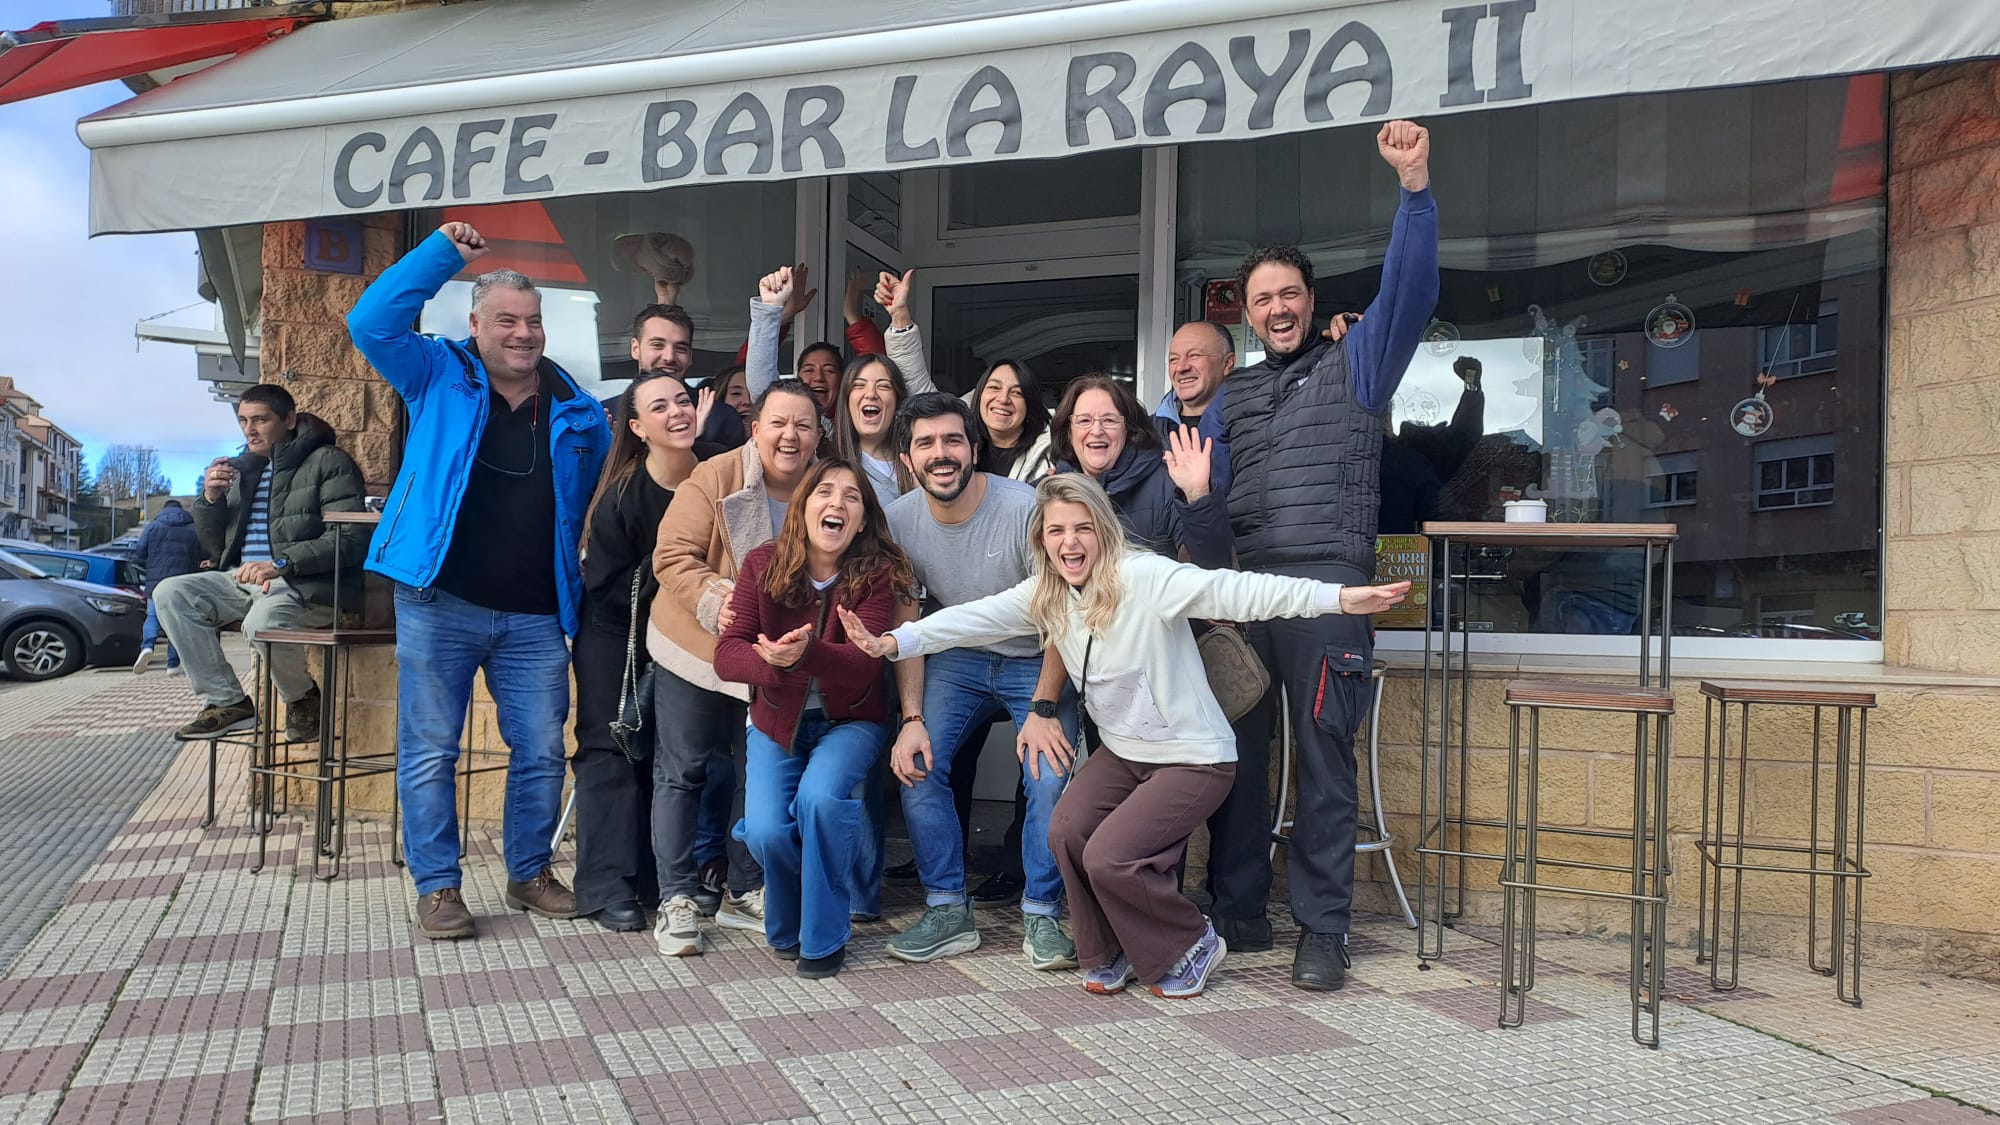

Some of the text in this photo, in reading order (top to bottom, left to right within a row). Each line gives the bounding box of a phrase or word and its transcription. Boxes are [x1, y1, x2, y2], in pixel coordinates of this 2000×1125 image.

[333, 0, 1536, 210] CAFE - BAR LA RAYA II
[318, 228, 351, 263] B
